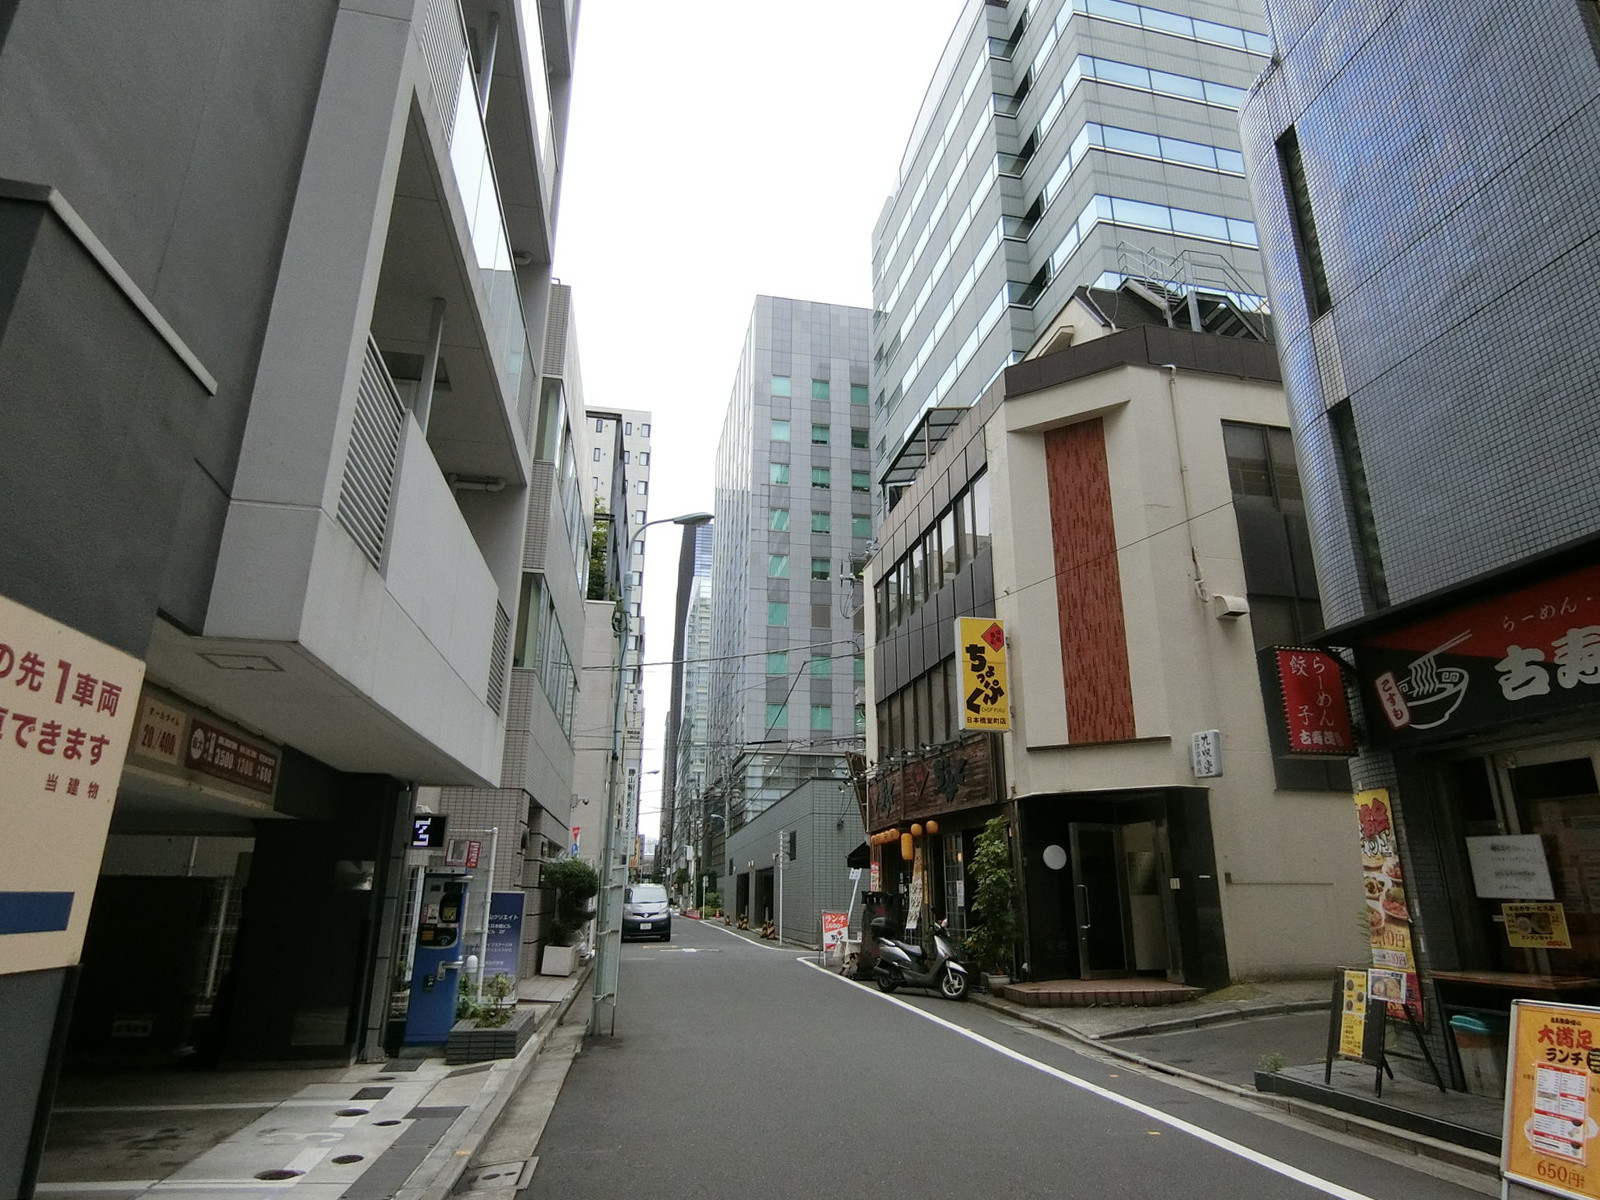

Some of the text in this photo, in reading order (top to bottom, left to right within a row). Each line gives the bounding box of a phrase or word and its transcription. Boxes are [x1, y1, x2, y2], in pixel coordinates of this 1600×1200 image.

[1289, 655, 1314, 727] 餃子
[1312, 655, 1336, 727] らーめん
[966, 717, 1007, 725] 日本橋室町店
[44, 773, 100, 799] 当建物
[1538, 1024, 1595, 1051] 大満足
[1546, 1048, 1584, 1066] ランチ
